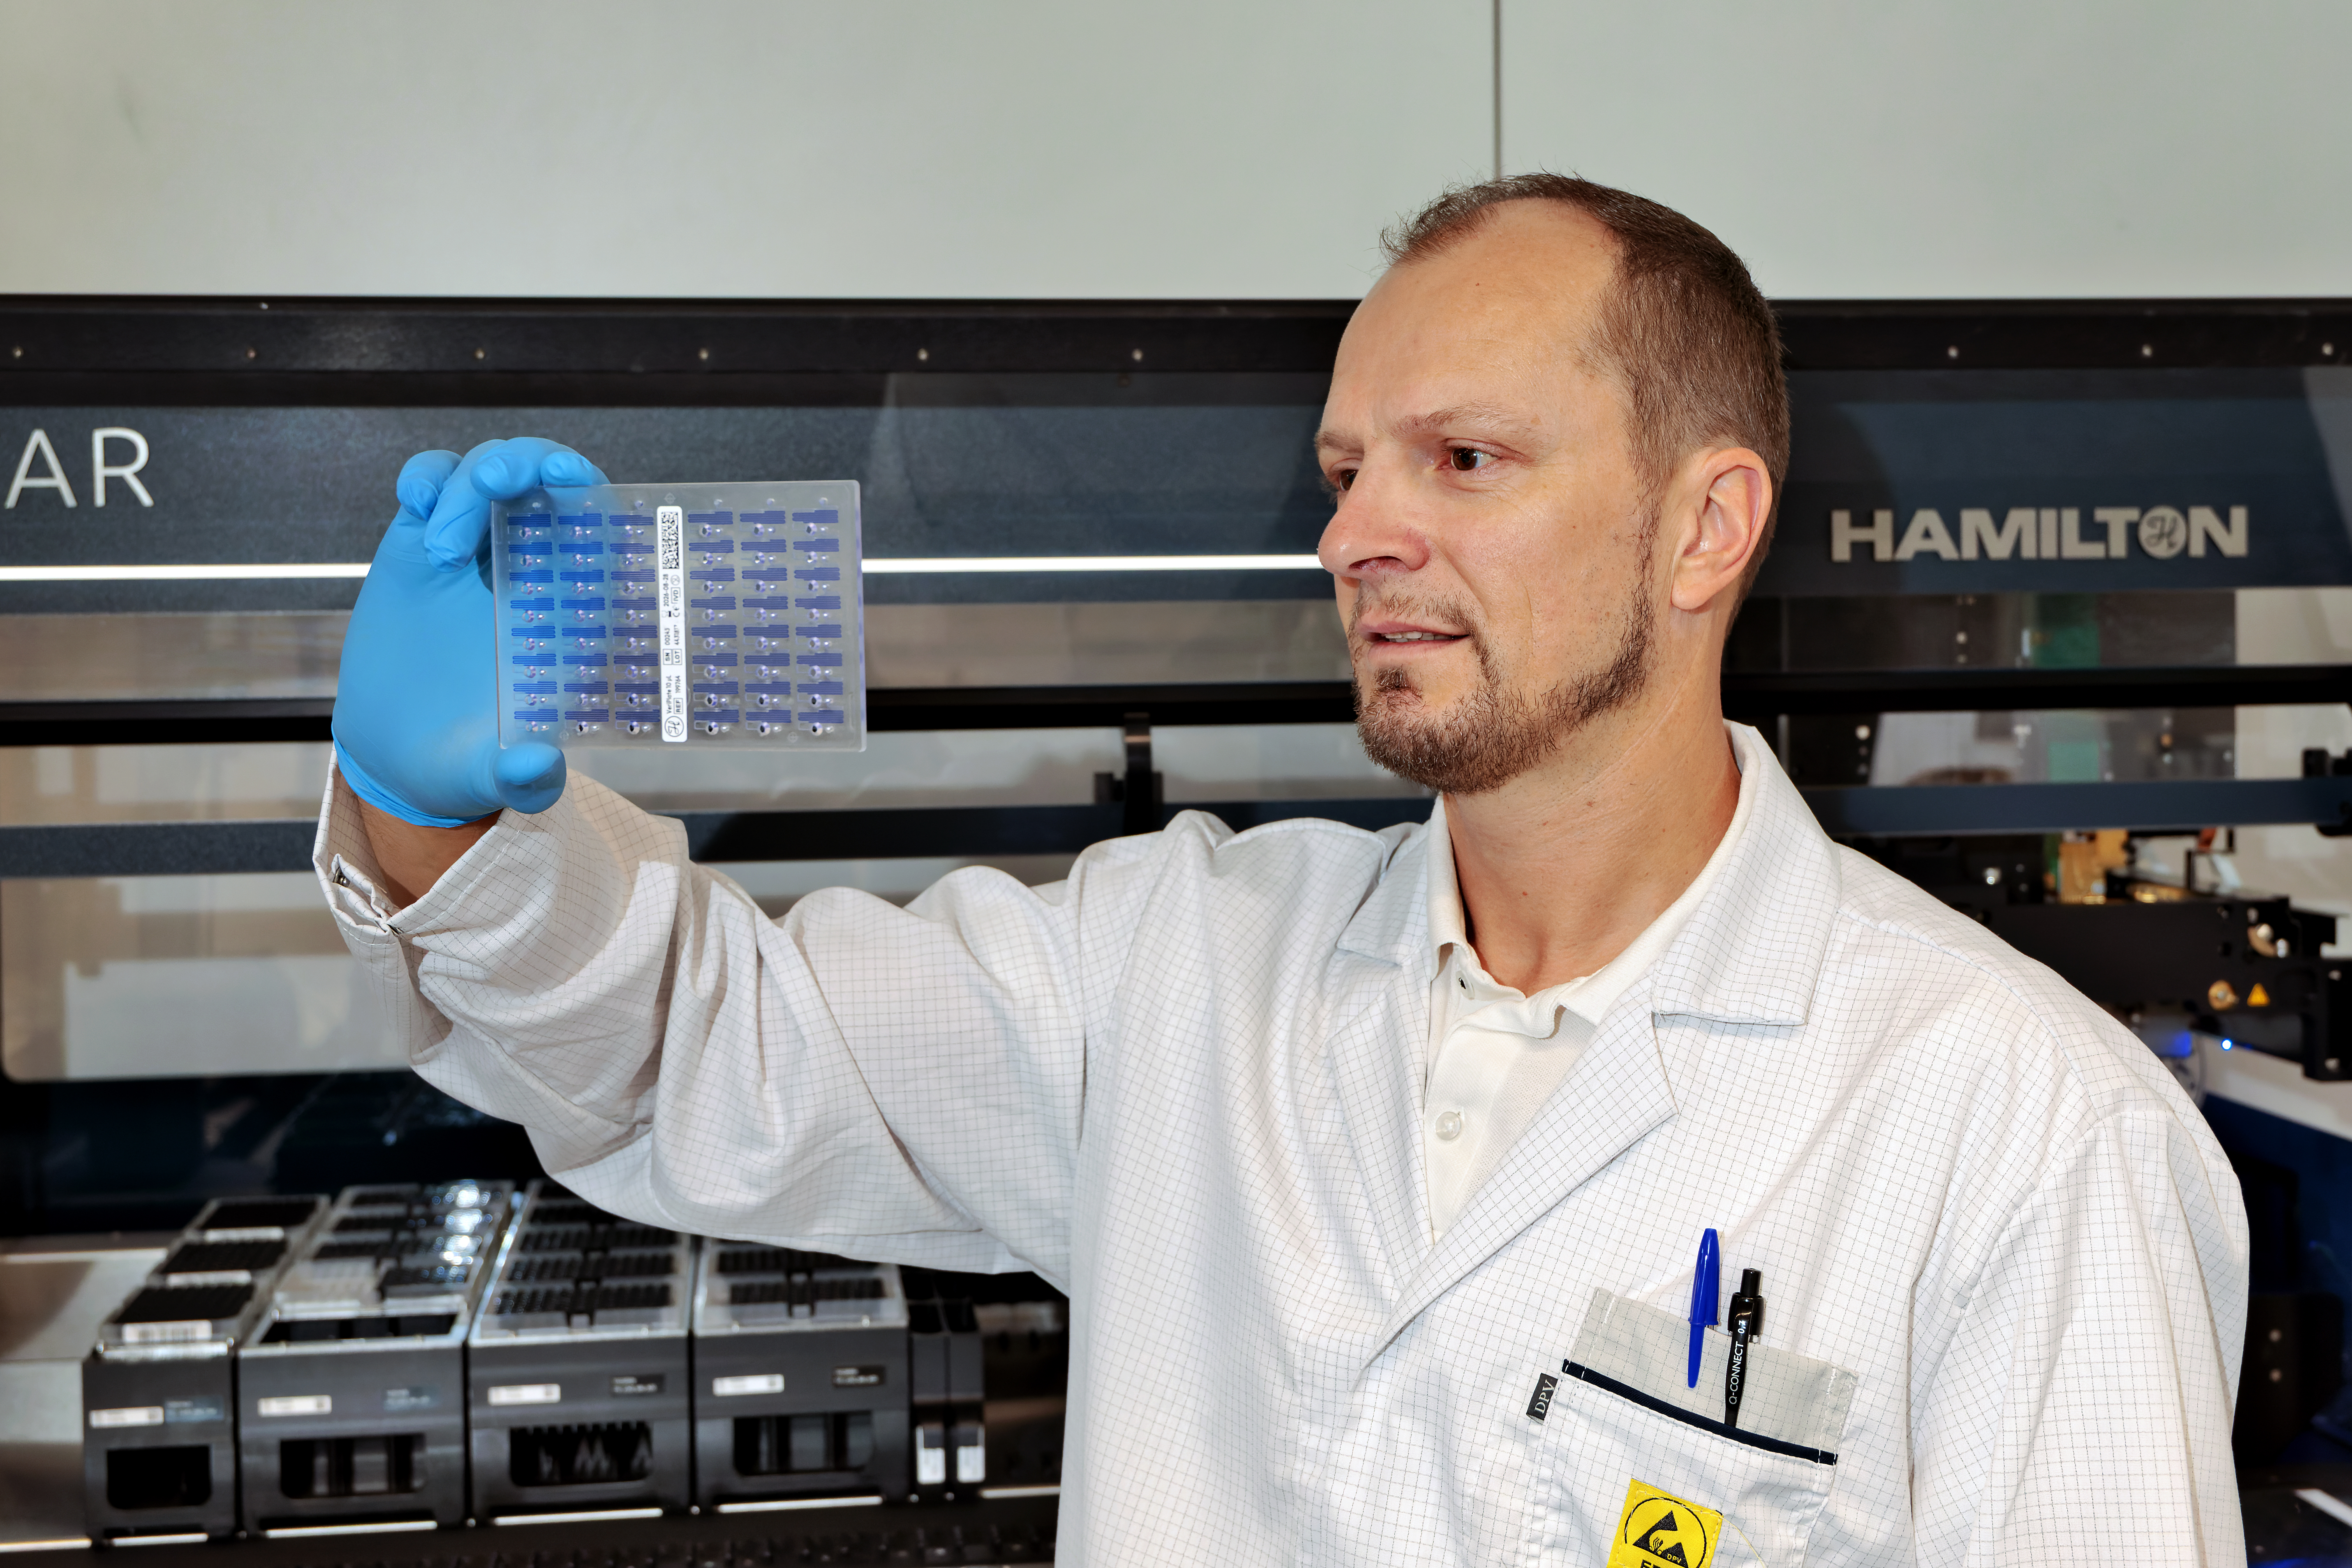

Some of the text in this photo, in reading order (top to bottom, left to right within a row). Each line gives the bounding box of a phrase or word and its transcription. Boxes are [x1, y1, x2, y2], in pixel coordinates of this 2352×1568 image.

[5, 427, 155, 509] AR
[1831, 505, 2248, 562] HAMILTON
[1534, 1379, 1555, 1414] DPV
[1729, 1341, 1744, 1404] Q-CONNECT
[1667, 1553, 1682, 1564] DPV
